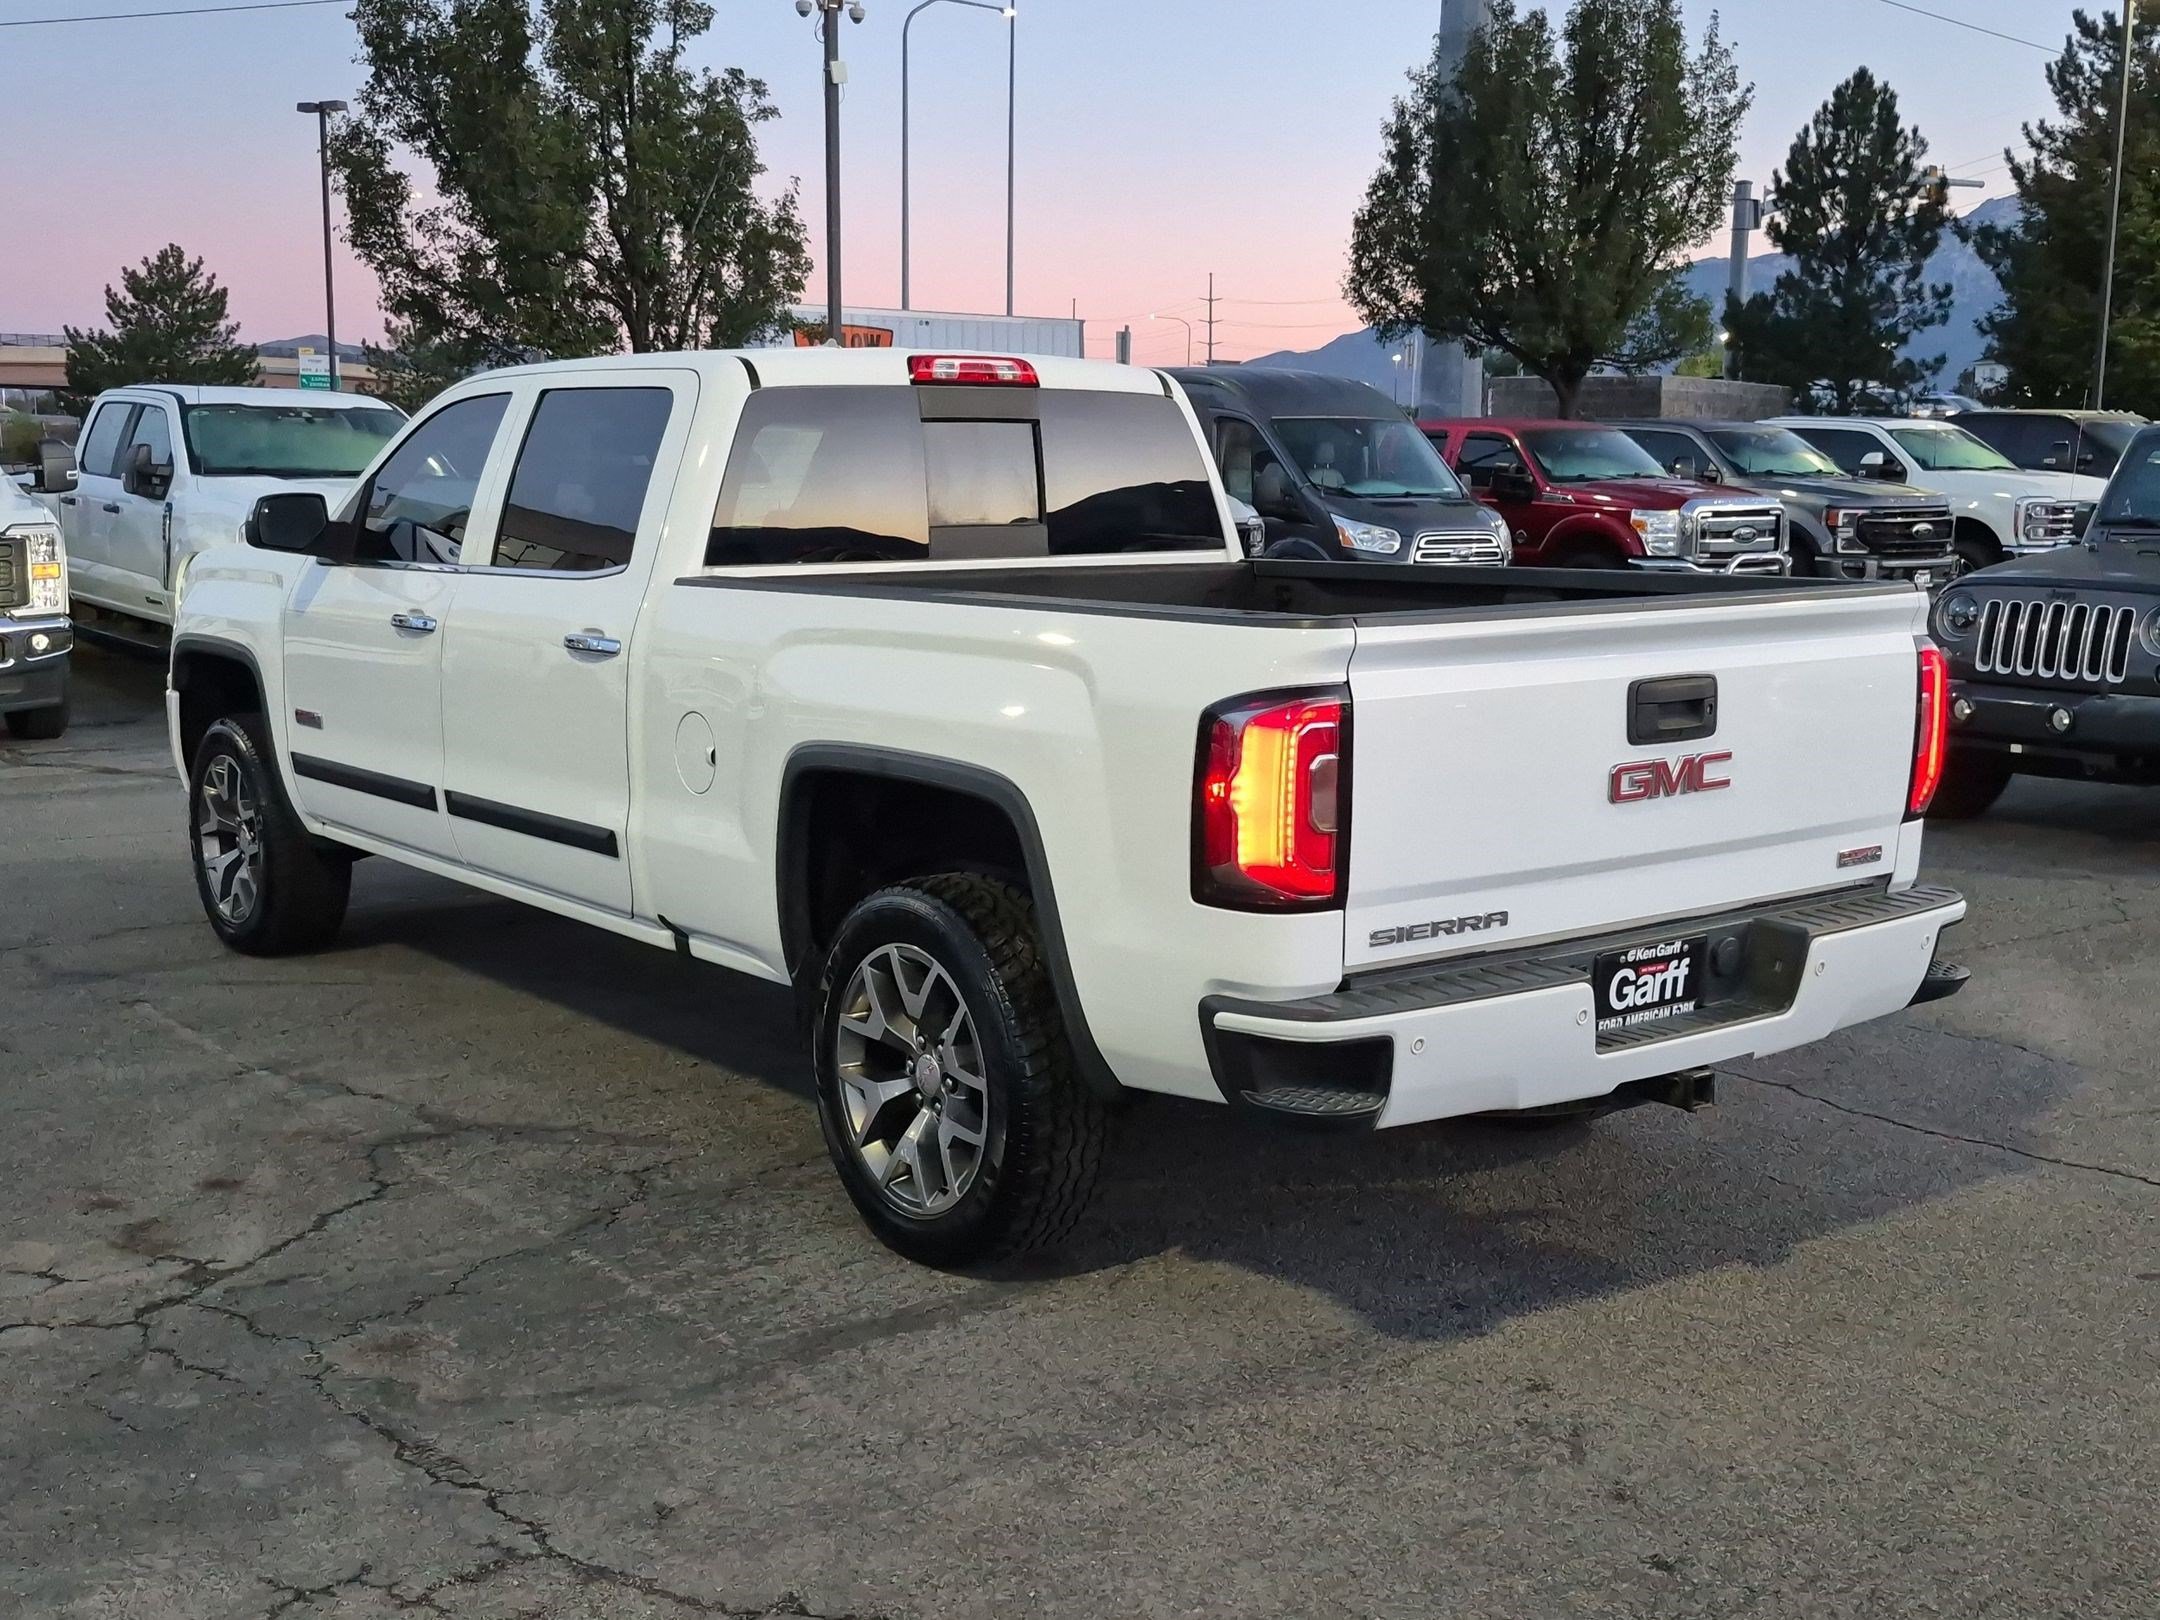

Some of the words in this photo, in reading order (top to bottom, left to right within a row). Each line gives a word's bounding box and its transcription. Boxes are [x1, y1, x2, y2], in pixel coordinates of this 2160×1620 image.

[1608, 749, 1733, 805] GMC
[1368, 910, 1509, 948] SIERRA
[1636, 947, 1656, 961] Ken
[1657, 940, 1682, 957] Garff
[1609, 957, 1691, 1011] Garff
[1598, 1017, 1623, 1031] FORD
[1625, 1006, 1671, 1026] AMERICAN
